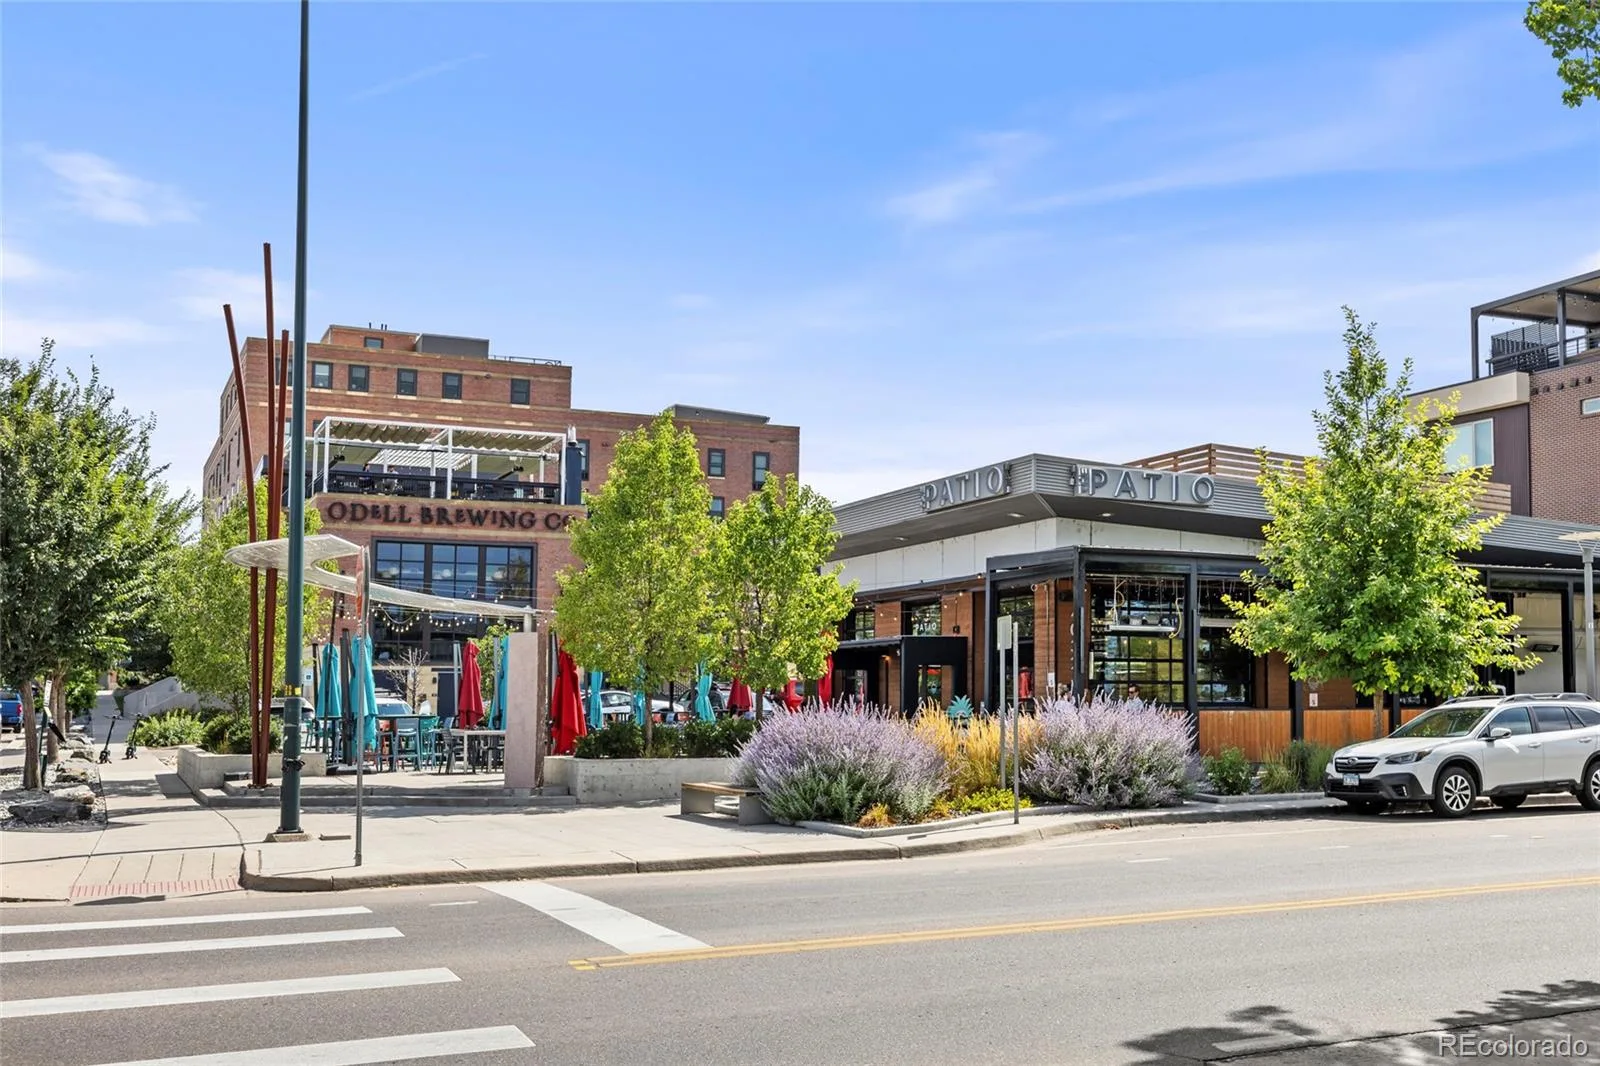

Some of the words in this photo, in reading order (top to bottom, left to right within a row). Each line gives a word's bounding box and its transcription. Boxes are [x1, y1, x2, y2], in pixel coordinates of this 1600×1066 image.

[925, 466, 1003, 509] PATIO
[1088, 468, 1214, 503] PATIO
[327, 502, 411, 523] ODELL
[421, 506, 536, 529] BREWING
